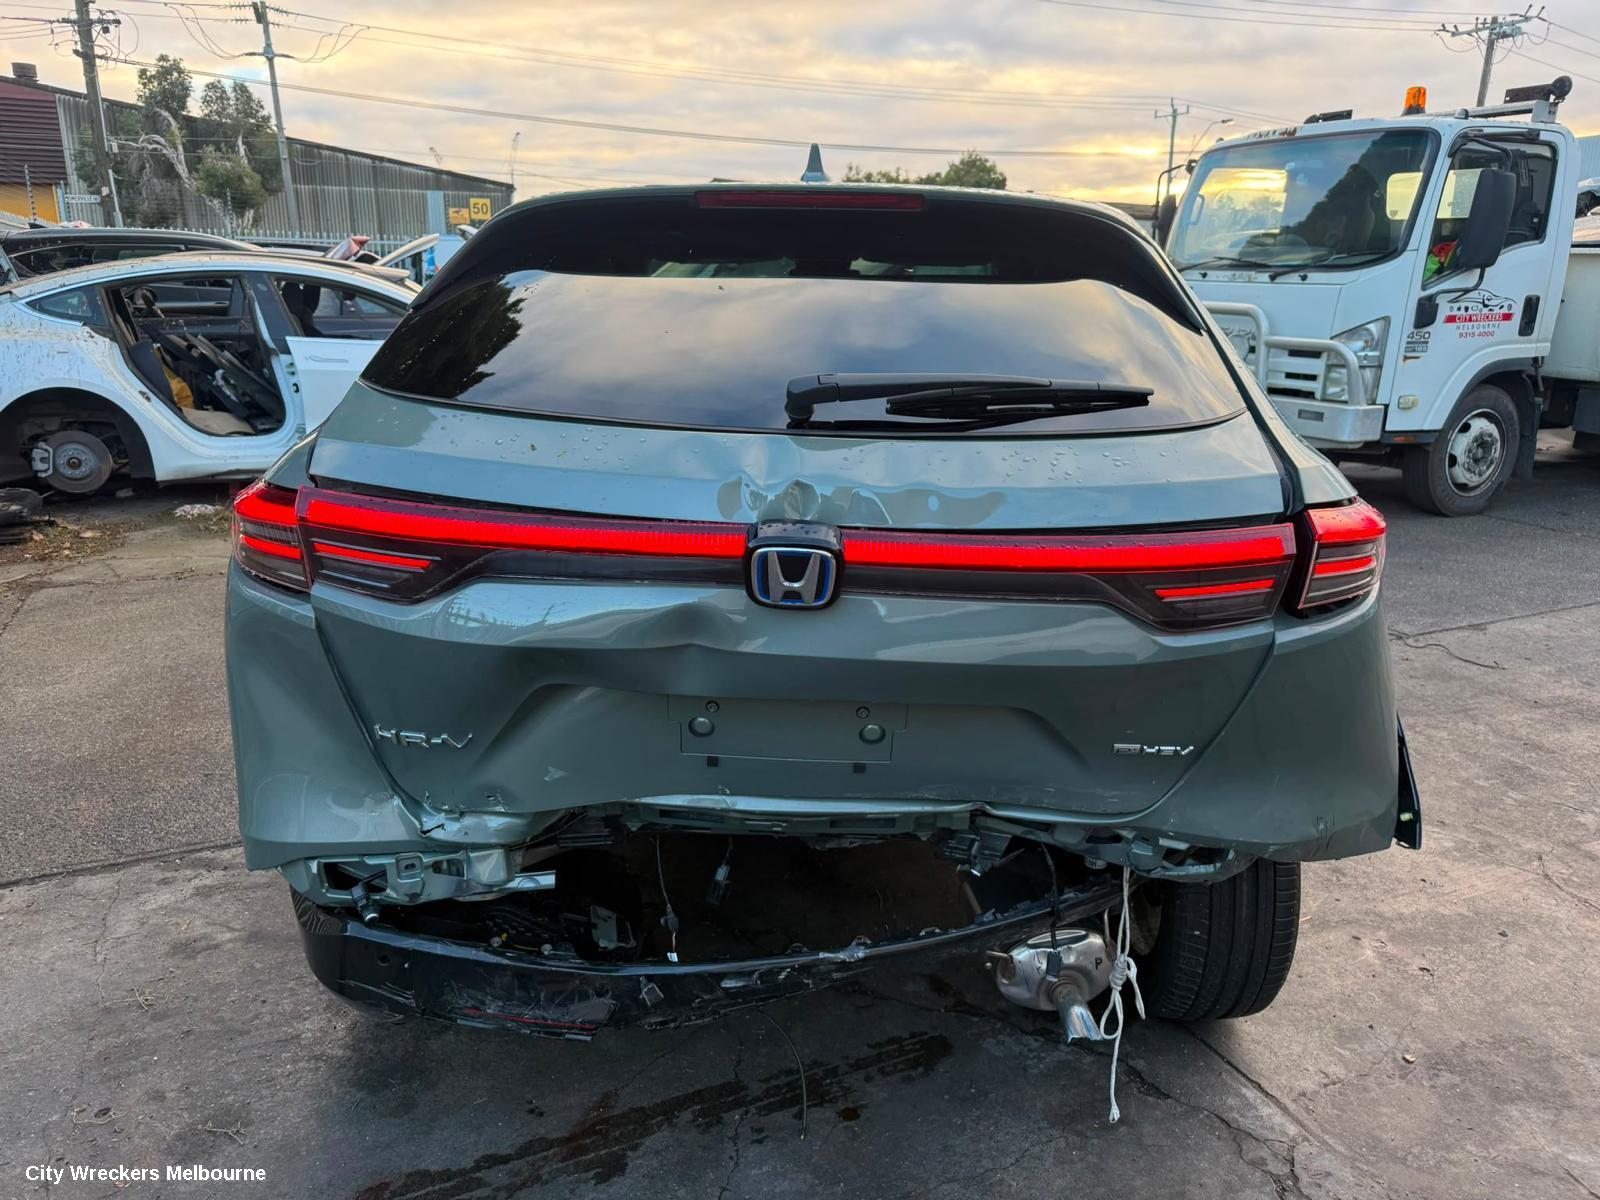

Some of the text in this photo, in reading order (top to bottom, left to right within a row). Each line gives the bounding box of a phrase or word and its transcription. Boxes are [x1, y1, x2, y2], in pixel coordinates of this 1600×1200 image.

[473, 203, 488, 215] 50
[1456, 312, 1503, 323] CITY WRECKERS
[1407, 331, 1431, 340] 450
[374, 724, 473, 749] HR-V
